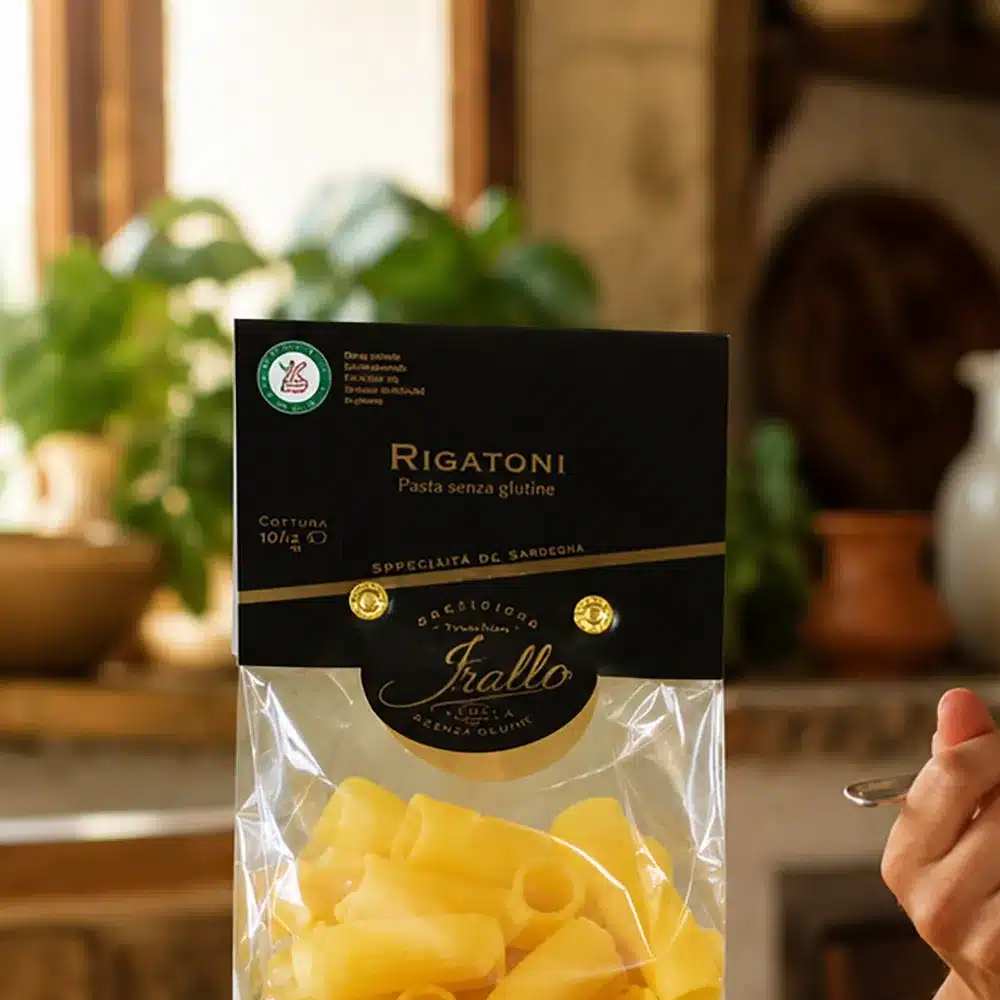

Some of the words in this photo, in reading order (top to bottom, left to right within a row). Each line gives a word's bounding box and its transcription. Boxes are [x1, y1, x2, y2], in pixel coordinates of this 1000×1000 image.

[390, 442, 566, 475] RIGATONI
[398, 476, 443, 494] Pasta
[447, 482, 494, 495] senza
[498, 480, 556, 499] glutine
